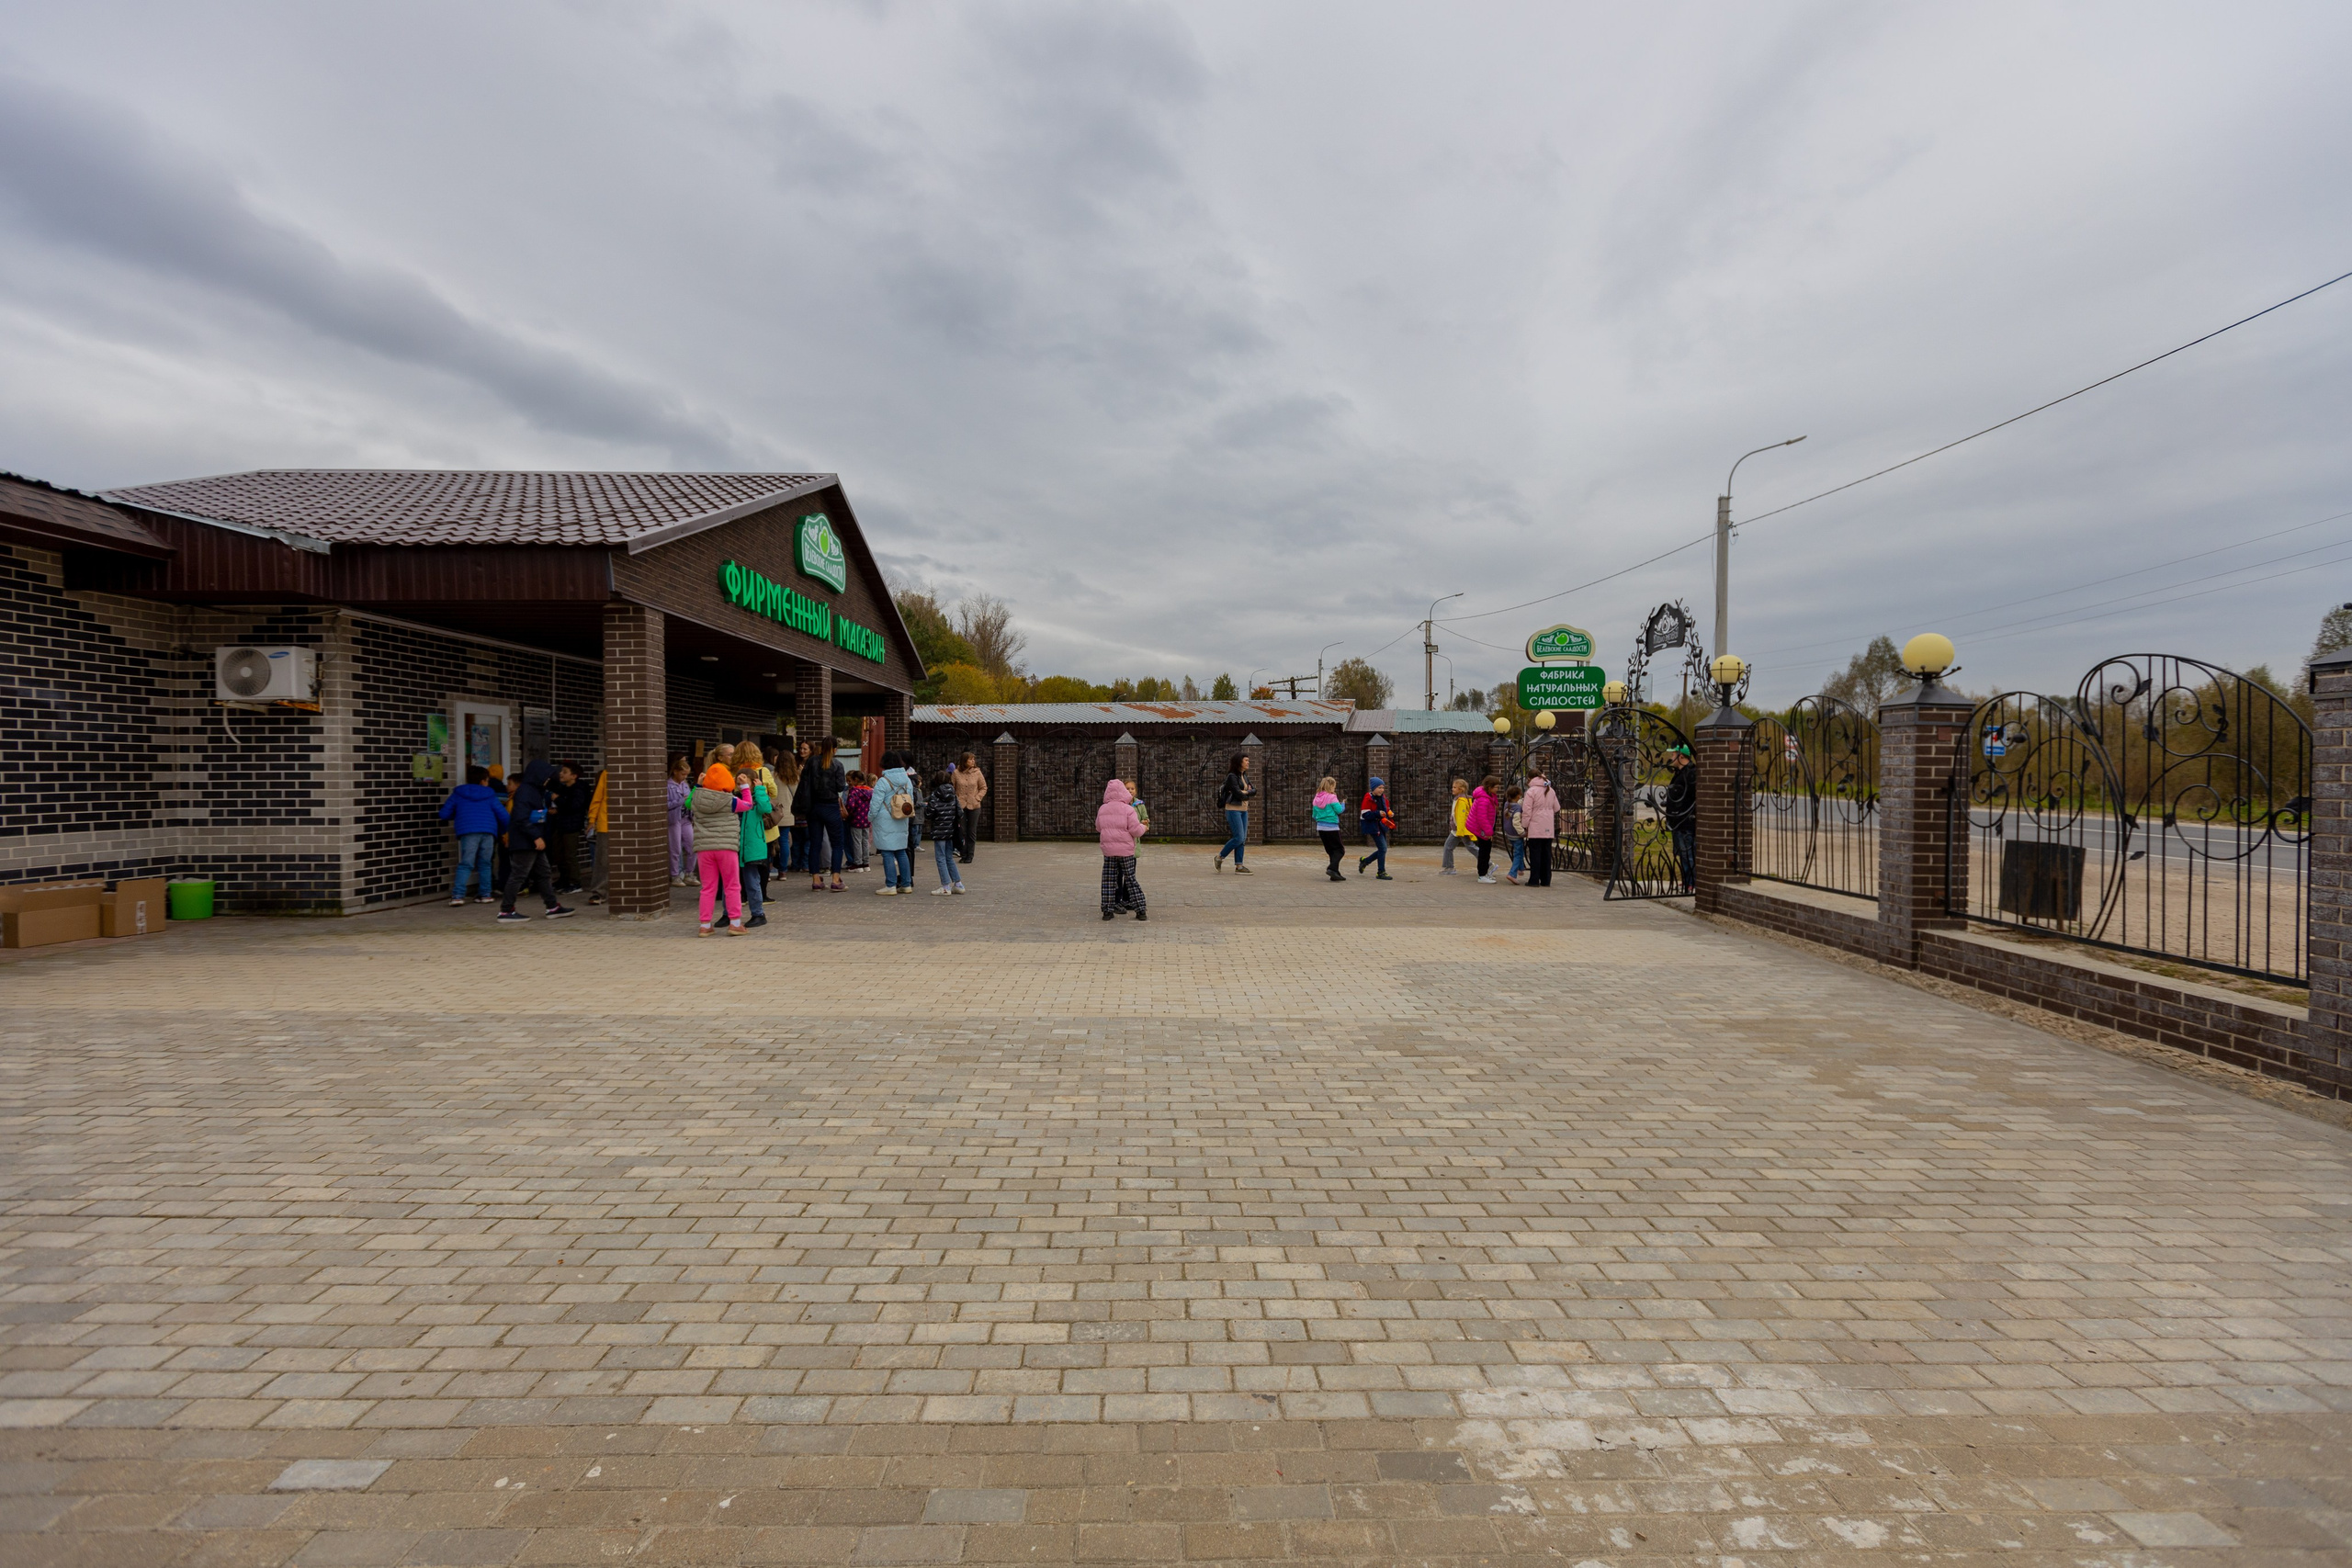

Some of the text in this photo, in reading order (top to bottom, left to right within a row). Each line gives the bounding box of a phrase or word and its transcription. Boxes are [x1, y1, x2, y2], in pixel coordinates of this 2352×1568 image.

[725, 559, 886, 664] ФИРМЕННЫЙ МАГАЗИН
[1536, 644, 1588, 653] БЕЛЕВСКИЕ СЛАДОСТИ
[1540, 670, 1585, 680] ФАБРИКА
[1526, 682, 1599, 693] НАТУРАЛЬНЫХ
[1529, 694, 1596, 706] СЛАДОСТЕЙ
